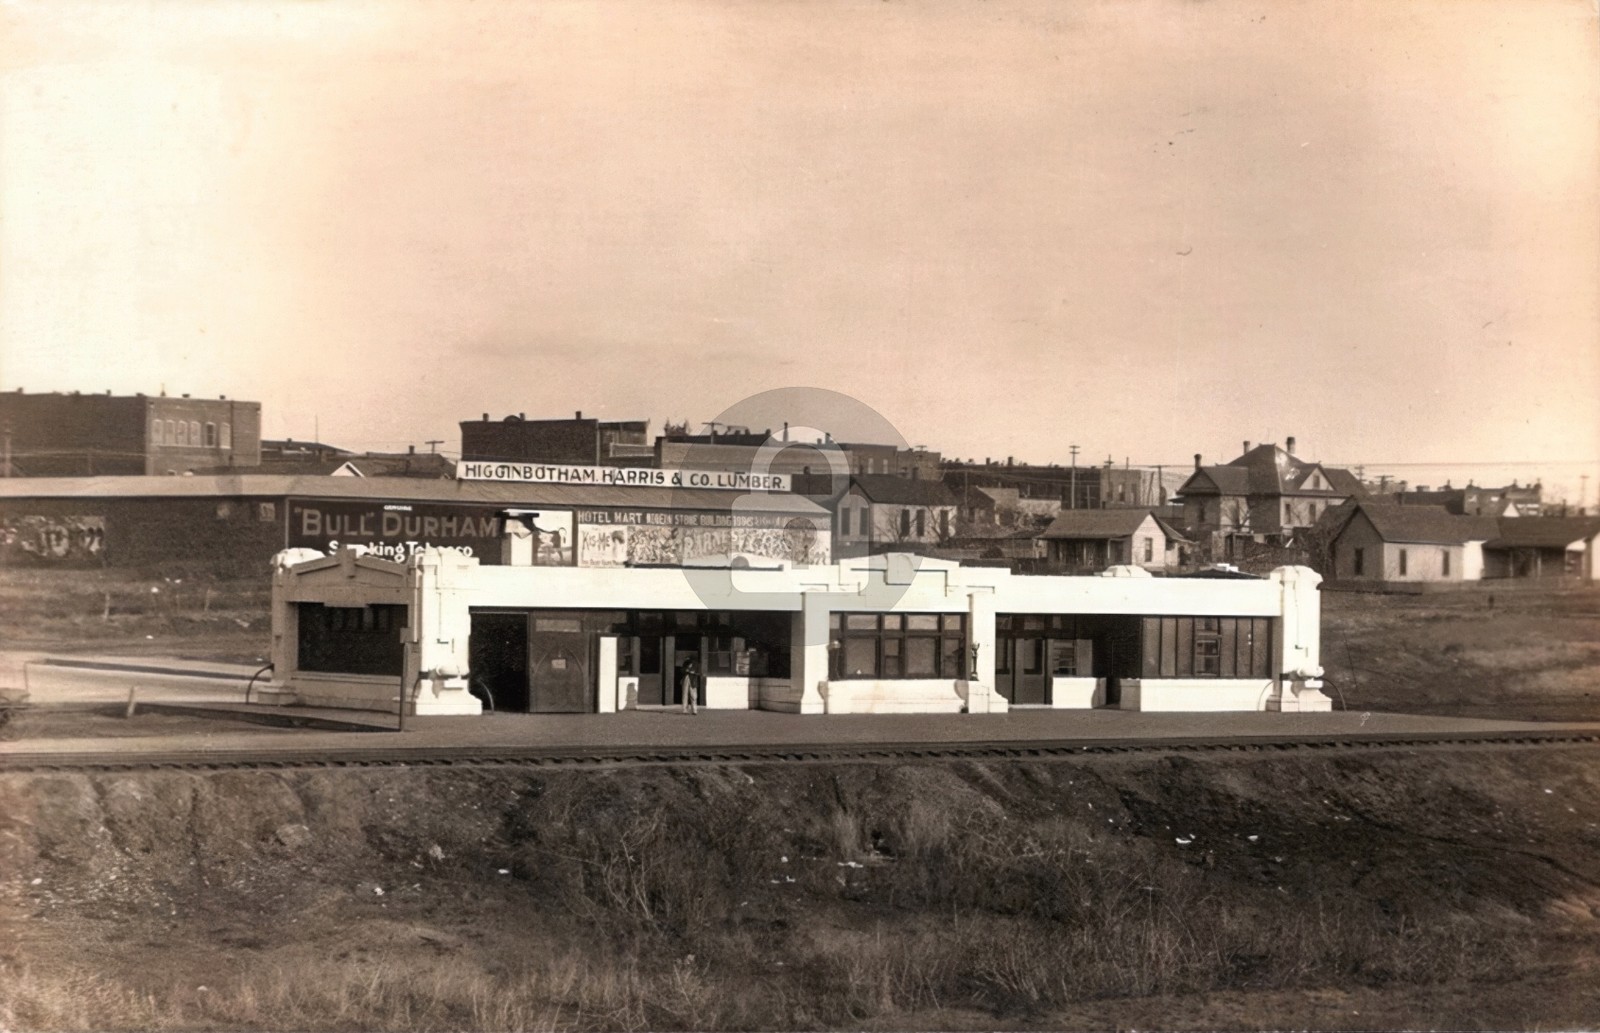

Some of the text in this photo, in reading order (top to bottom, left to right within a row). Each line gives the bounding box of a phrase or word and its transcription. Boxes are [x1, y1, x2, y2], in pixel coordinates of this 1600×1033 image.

[602, 469, 665, 485] HARRIS
[671, 471, 682, 486] &
[382, 512, 497, 537] DURHAM
[578, 510, 611, 523] HOTEL
